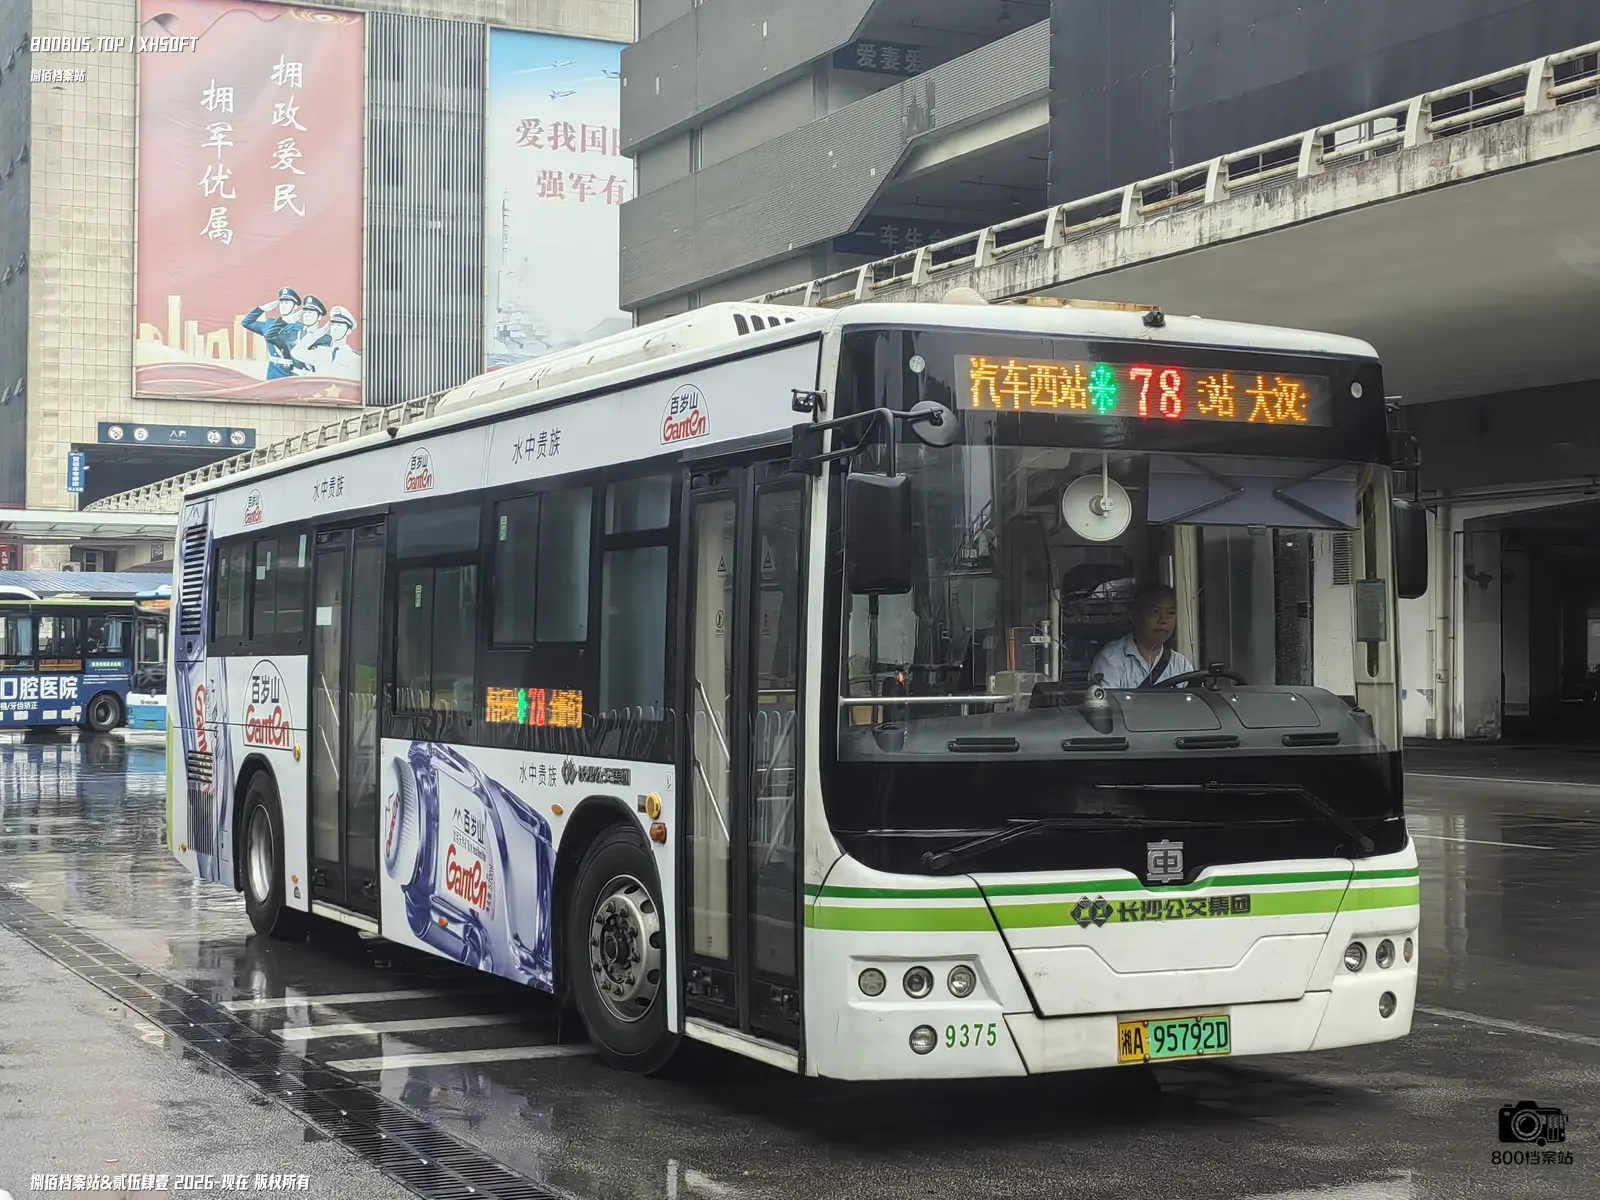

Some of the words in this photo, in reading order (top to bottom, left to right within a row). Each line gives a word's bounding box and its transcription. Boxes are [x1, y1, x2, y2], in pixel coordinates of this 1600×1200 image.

[270, 53, 308, 218] 拥政爱民
[515, 117, 620, 157] 爱我国
[198, 78, 237, 246] 拥军优属
[536, 169, 628, 205] 强军有
[670, 391, 699, 415] 百岁山
[970, 357, 1088, 410] 汽车西站
[1129, 367, 1182, 419] 78
[1246, 375, 1307, 422] 大汉
[663, 409, 706, 441] Ganten
[511, 427, 562, 465] 水中贵族
[312, 473, 345, 502] 水中贵族
[0, 676, 78, 700] 口腔医院
[252, 675, 279, 703] 百岁山
[245, 704, 290, 747] Ganten
[519, 762, 557, 787] 水中贵族
[463, 808, 484, 844] 百岁山
[1117, 893, 1251, 922] 长沙公交集团
[945, 1023, 997, 1048] 9375
